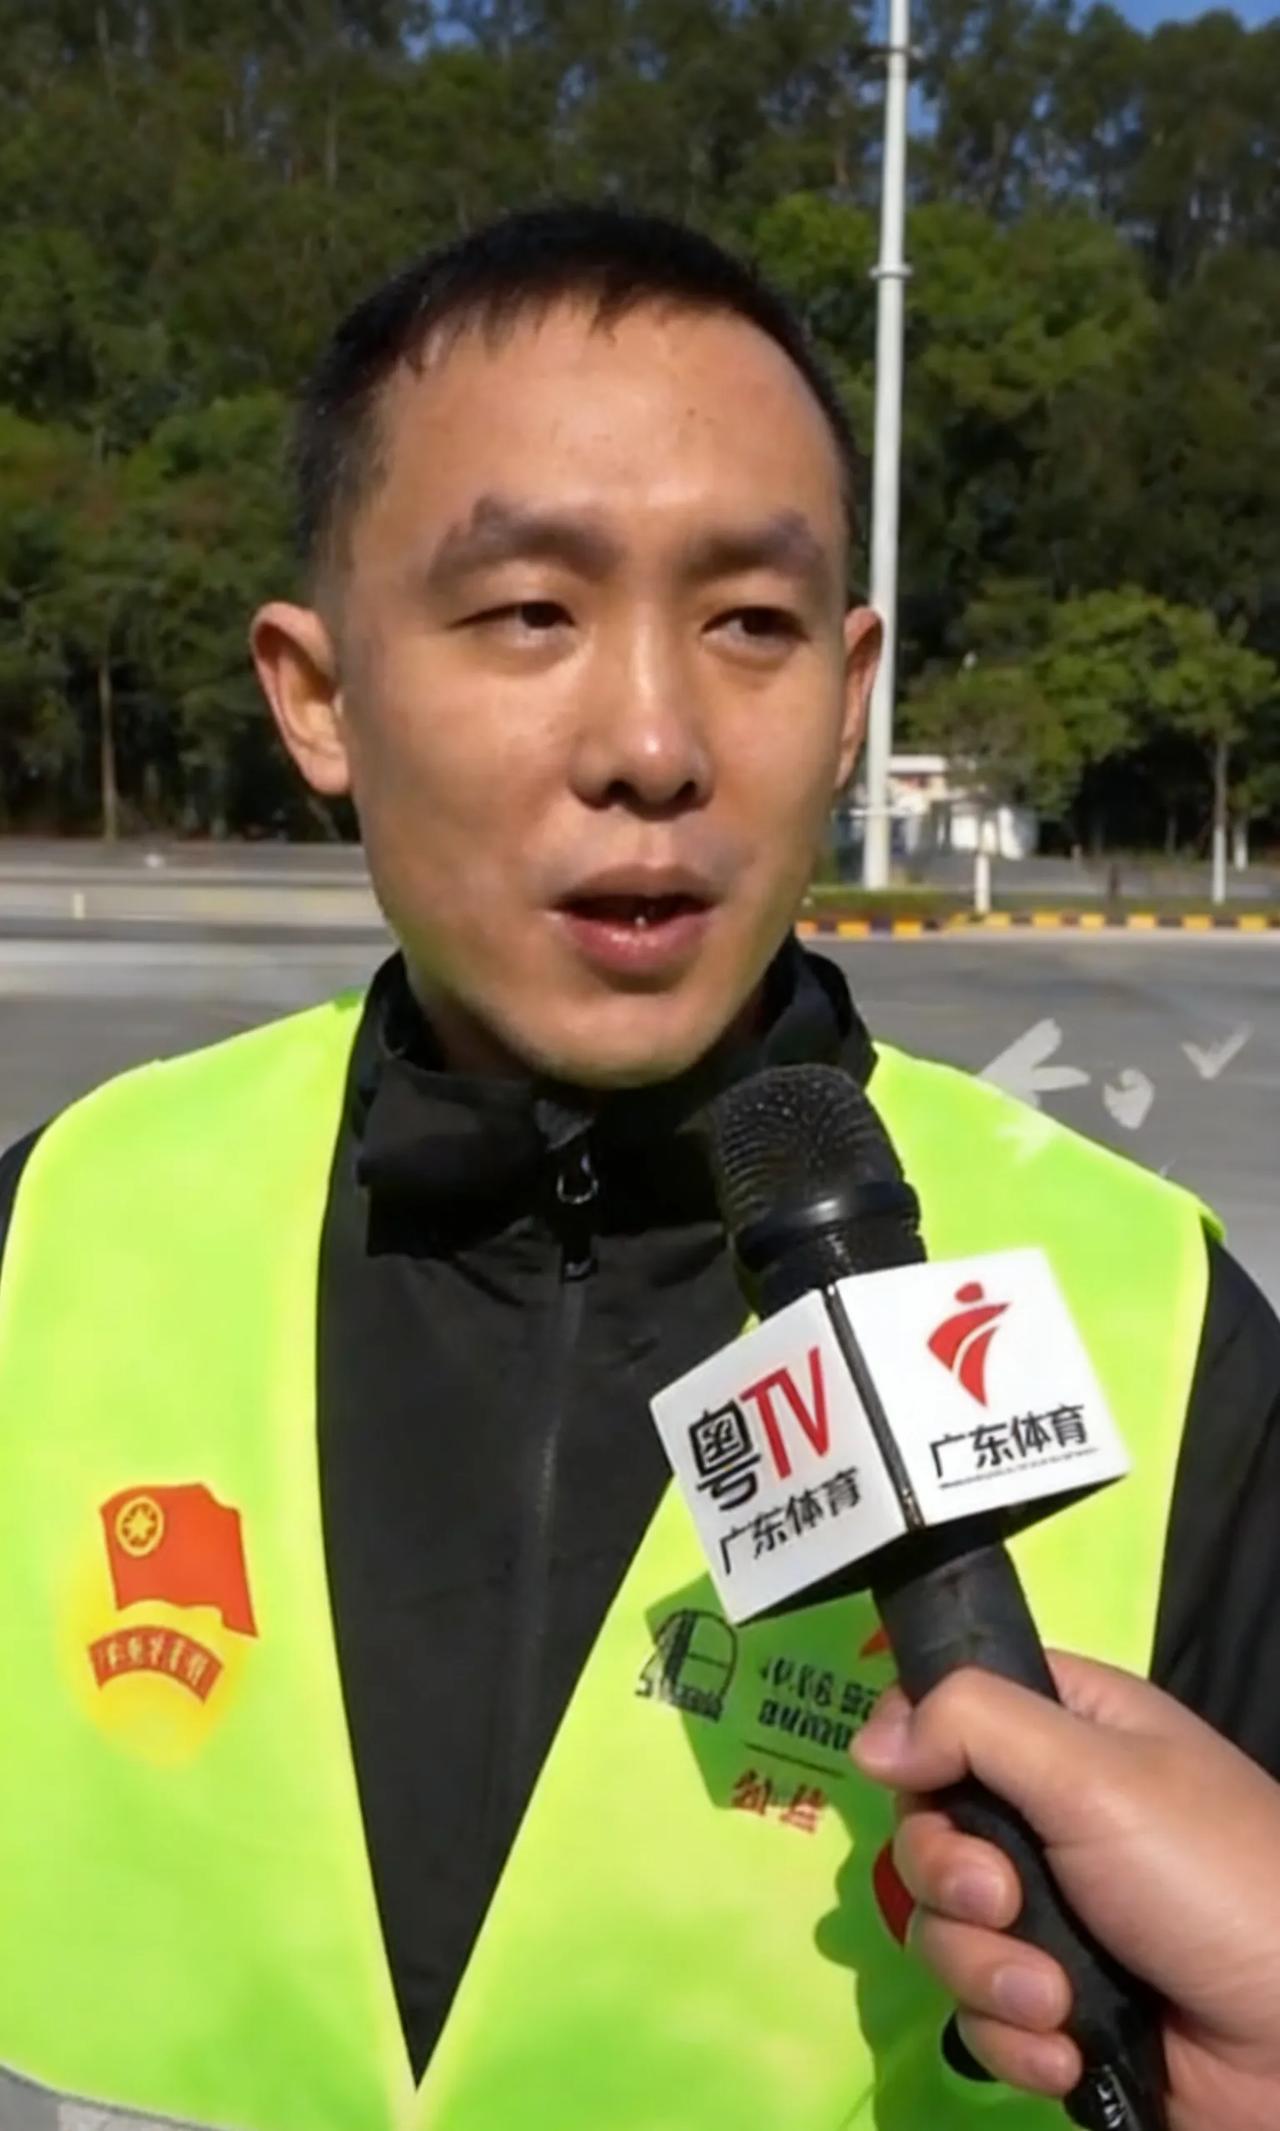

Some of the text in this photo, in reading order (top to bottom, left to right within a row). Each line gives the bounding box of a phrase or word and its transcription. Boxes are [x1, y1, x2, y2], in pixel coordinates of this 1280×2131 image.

[929, 1403, 1088, 1479] 广东体育
[719, 1466, 863, 1576] 广东体育
